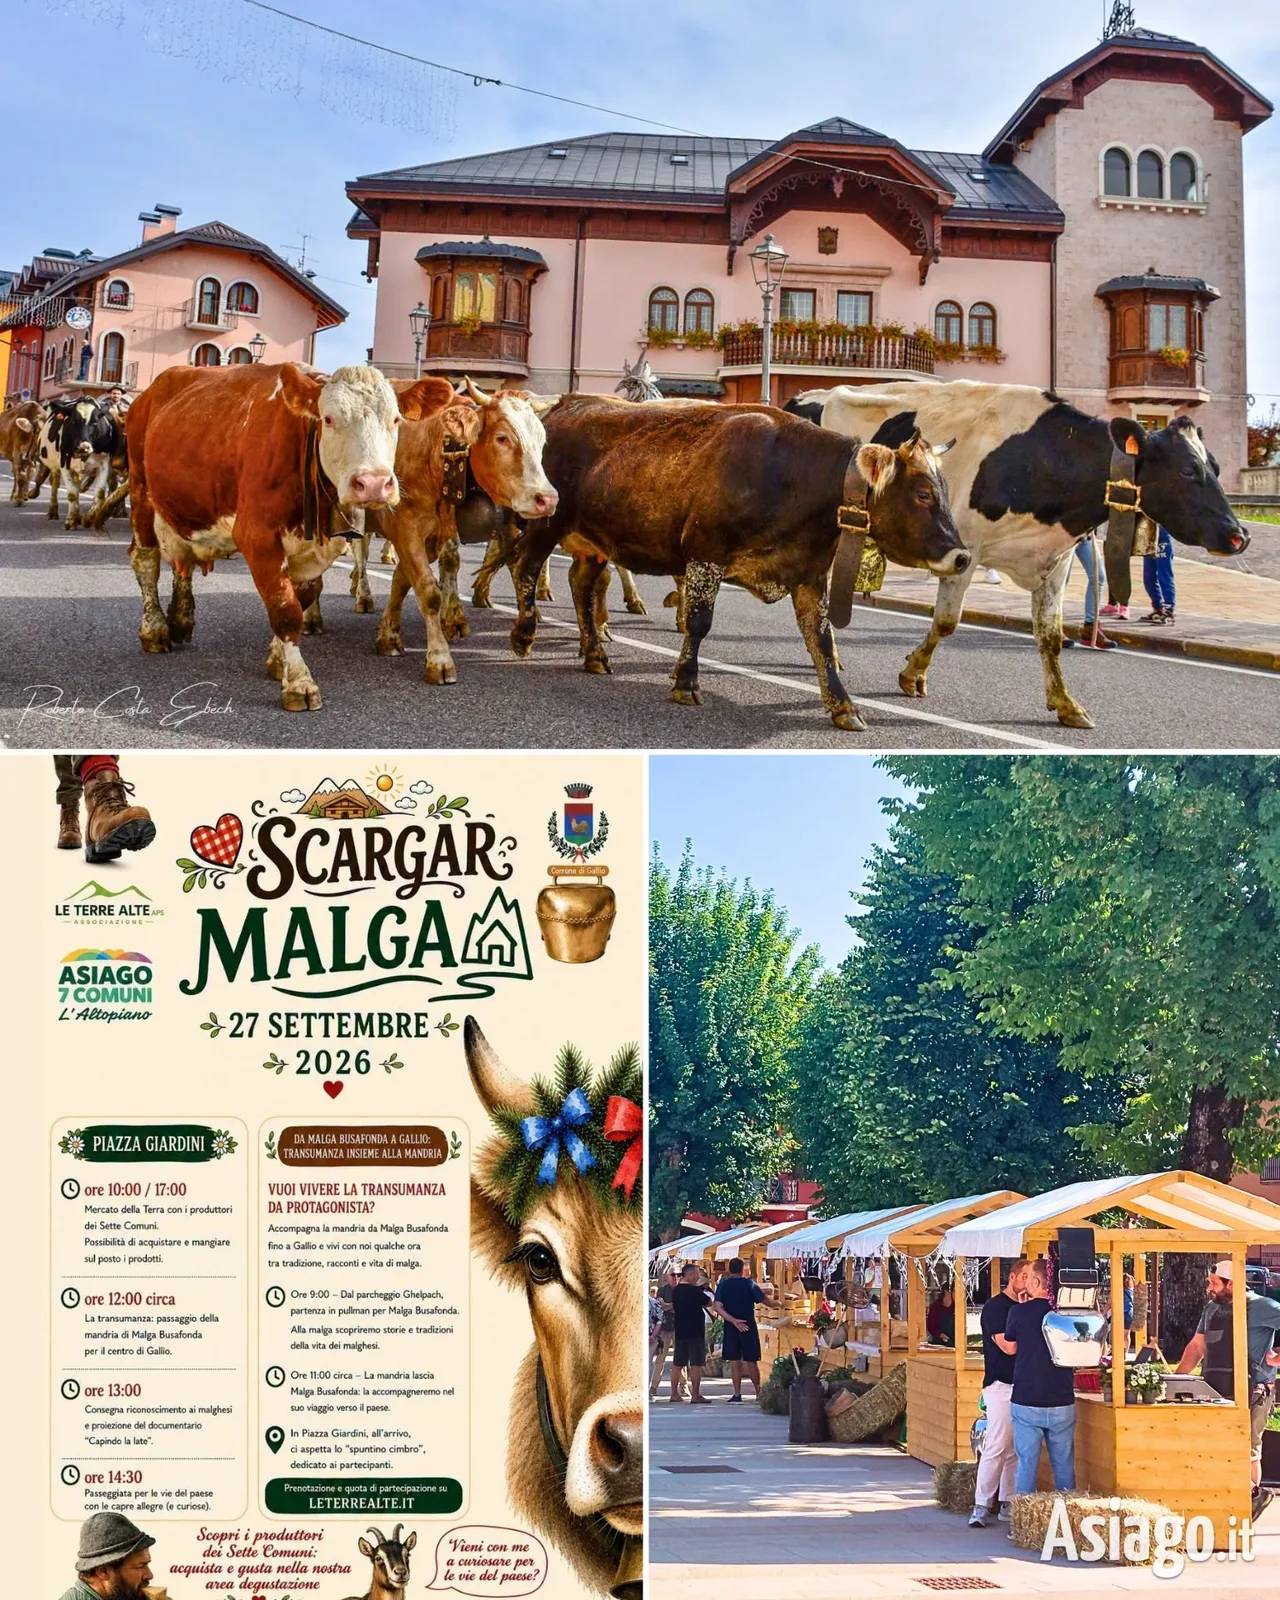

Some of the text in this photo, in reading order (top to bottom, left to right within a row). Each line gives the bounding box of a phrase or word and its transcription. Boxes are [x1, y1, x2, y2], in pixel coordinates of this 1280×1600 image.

[246, 815, 514, 899] SCARGAR
[55, 904, 70, 916] LE
[73, 904, 115, 916] TERRE
[118, 904, 150, 916] ALTE
[180, 900, 458, 995] MALGA
[58, 965, 153, 985] ASIAGO
[58, 987, 152, 1003] 7 COMUNI
[229, 1012, 430, 1040] 27 SETTEMBRE
[295, 1049, 372, 1076] 2026
[93, 1136, 204, 1152] PIAZZA GIARDINI
[294, 1134, 305, 1144] DA
[308, 1134, 336, 1144] MALGA
[340, 1134, 388, 1144] BUSAFONDA
[398, 1134, 430, 1144] GALLIO:
[284, 1149, 442, 1159] TRANSUMANZA INSIEME ALLA MANDRIA
[84, 1186, 104, 1196] ore
[108, 1182, 141, 1196] 10:00
[156, 1183, 186, 1196] 17:00
[268, 1183, 446, 1196] VUOI VIVERE LA TRANSUMANZA
[85, 1205, 118, 1214] Mercato
[121, 1205, 140, 1214] della
[143, 1205, 164, 1214] Terra
[190, 1205, 232, 1216] produttori
[268, 1201, 375, 1213] DA PROTAGONISTA?
[84, 1221, 158, 1230] dei Sette Comuni.
[268, 1224, 448, 1235] Accompagna la mandria da Malga Busafonda
[85, 1237, 125, 1246] Possibilità
[128, 1238, 136, 1246] di
[138, 1238, 181, 1248] acquistare
[192, 1238, 230, 1249] mangiare
[84, 1292, 176, 1306] ore 12:00 circa
[85, 1314, 95, 1322] La
[156, 1314, 197, 1325] passaggio
[200, 1314, 219, 1322] della
[85, 1330, 202, 1341] mandria di Malga Busafonda
[291, 1325, 306, 1334] Alla
[309, 1325, 333, 1336] malga
[336, 1326, 381, 1336] scopriremo
[383, 1326, 406, 1334] storie
[416, 1325, 453, 1334] tradizioni
[85, 1349, 98, 1358] per
[101, 1346, 105, 1355] il
[136, 1346, 144, 1355] di
[146, 1346, 172, 1355] Gallio.
[290, 1341, 309, 1350] della
[329, 1341, 341, 1350] dei
[343, 1341, 380, 1352] malghesi.
[84, 1383, 141, 1397] ore 13:00
[291, 1387, 454, 1398] Malga Busafonda: la accompagneremo nel
[85, 1405, 232, 1416] Consegna riconoscimento ai malghesi
[92, 1422, 132, 1432] proiezione
[134, 1421, 146, 1429] del
[148, 1421, 202, 1430] documentario
[291, 1429, 299, 1437] In
[302, 1429, 328, 1437] Piazza
[331, 1428, 368, 1438] Giardini,
[124, 1436, 131, 1445] la
[290, 1445, 297, 1453] ci
[300, 1446, 332, 1456] aspetta
[334, 1444, 342, 1453] lo
[290, 1460, 393, 1471] dedicato ai partecipanti.
[84, 1470, 142, 1484] ore 14:30
[284, 1484, 335, 1492] Prenotazione
[345, 1485, 367, 1494] quota
[370, 1484, 378, 1492] di
[379, 1484, 436, 1494] partecipazione
[310, 1498, 414, 1508] LETERREALTE.IT
[196, 1527, 324, 1545] Scopri i produttori
[202, 1544, 317, 1558] dei Sette Comuni:
[449, 1539, 530, 1552] Vieni con me
[446, 1555, 535, 1571] a curiosare per
[169, 1561, 352, 1578] acquista e gusta nella nostra
[444, 1569, 540, 1585] le vie del paese?
[205, 1577, 320, 1594] area degustazione
